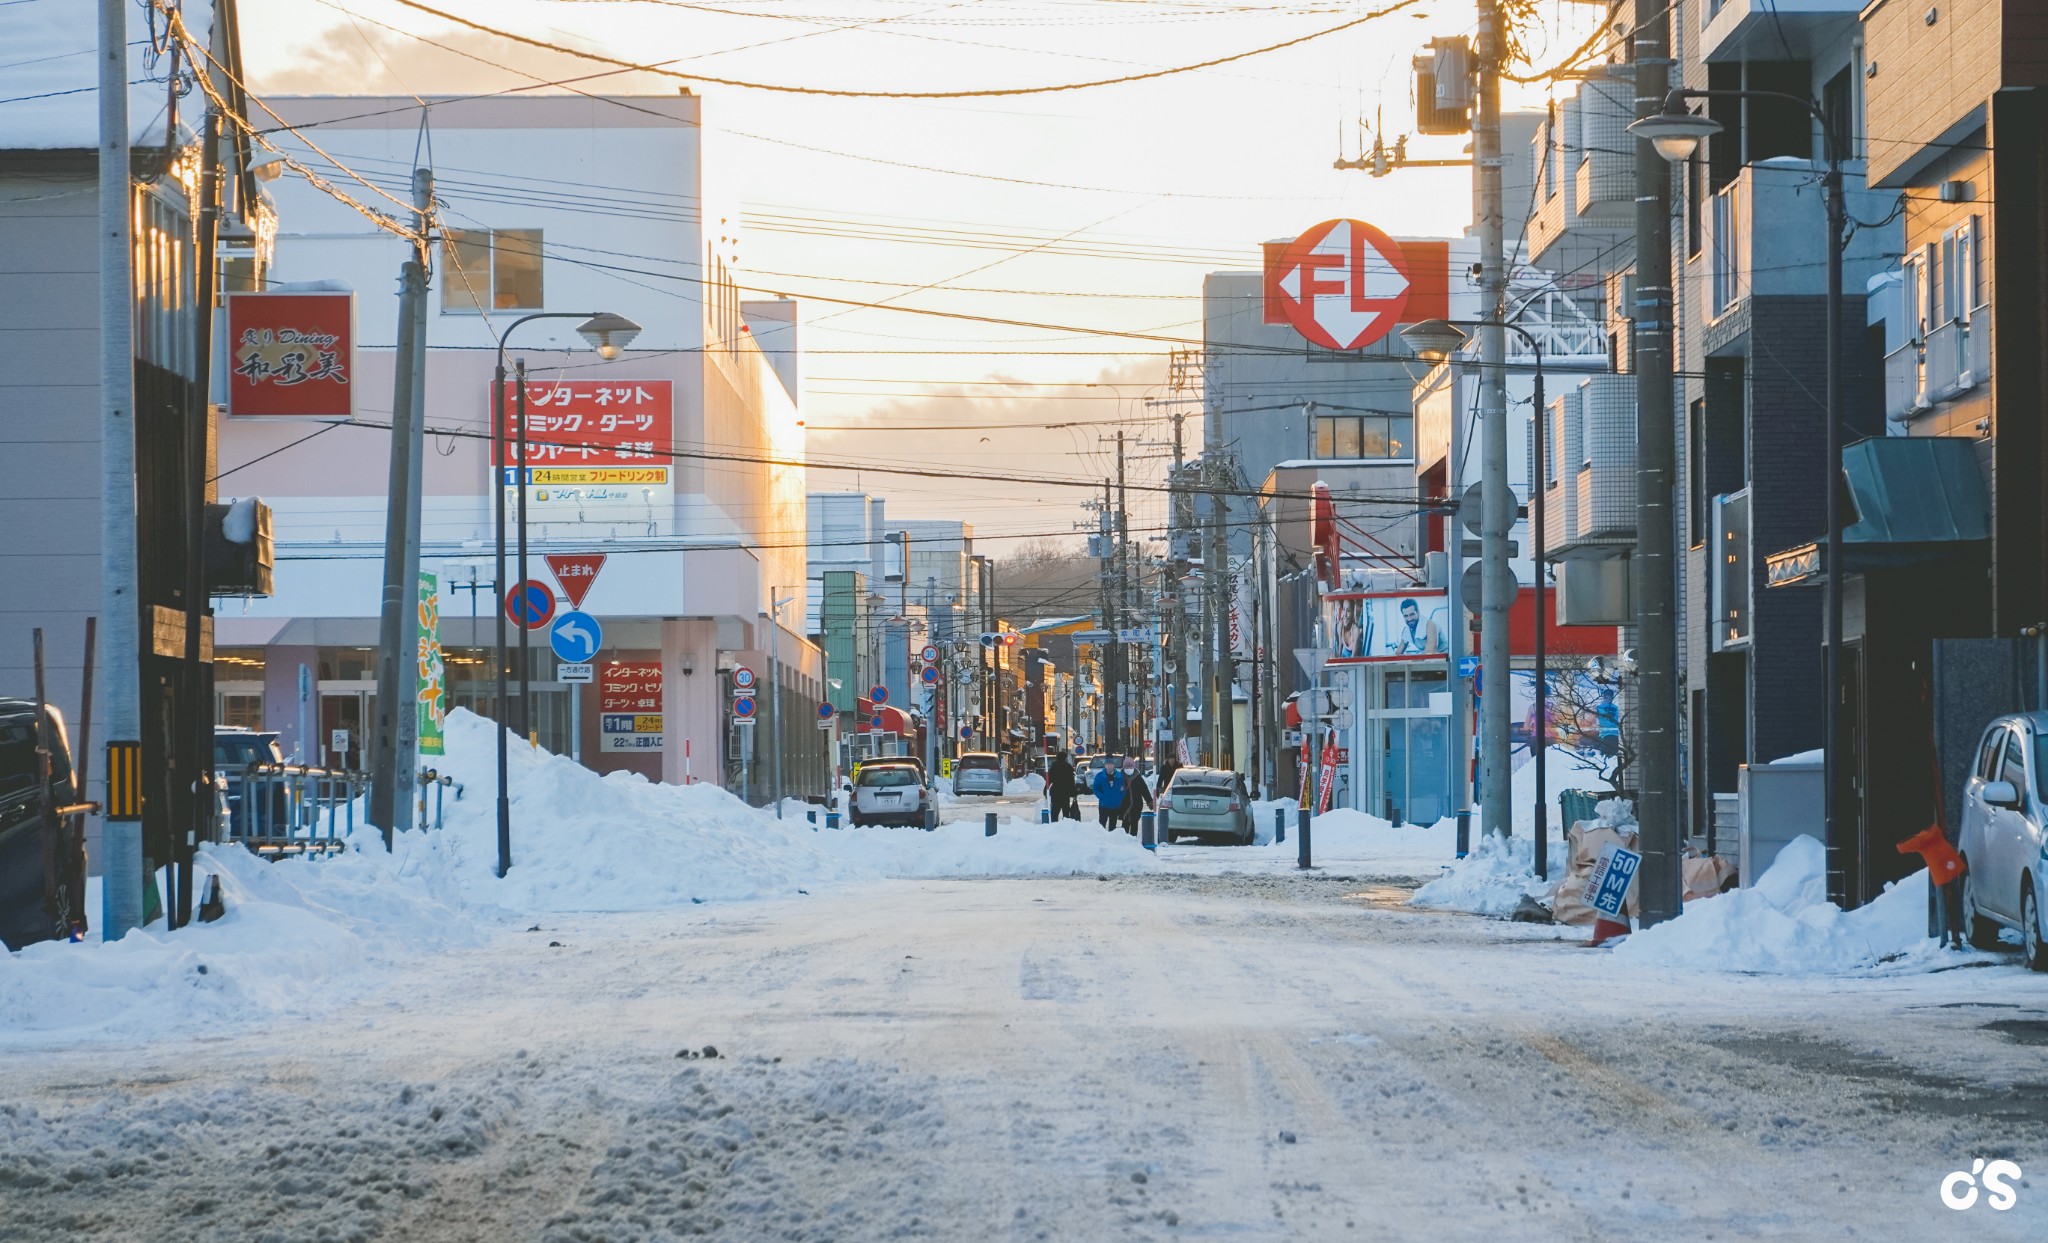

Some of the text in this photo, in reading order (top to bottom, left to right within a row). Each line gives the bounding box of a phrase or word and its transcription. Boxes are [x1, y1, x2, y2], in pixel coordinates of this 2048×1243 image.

[240, 329, 339, 349] 炙り Dining
[234, 352, 348, 386] 和彩美
[558, 564, 595, 577] 止まれ
[925, 649, 935, 659] 30
[604, 667, 662, 678] インターネット
[739, 673, 751, 683] 30
